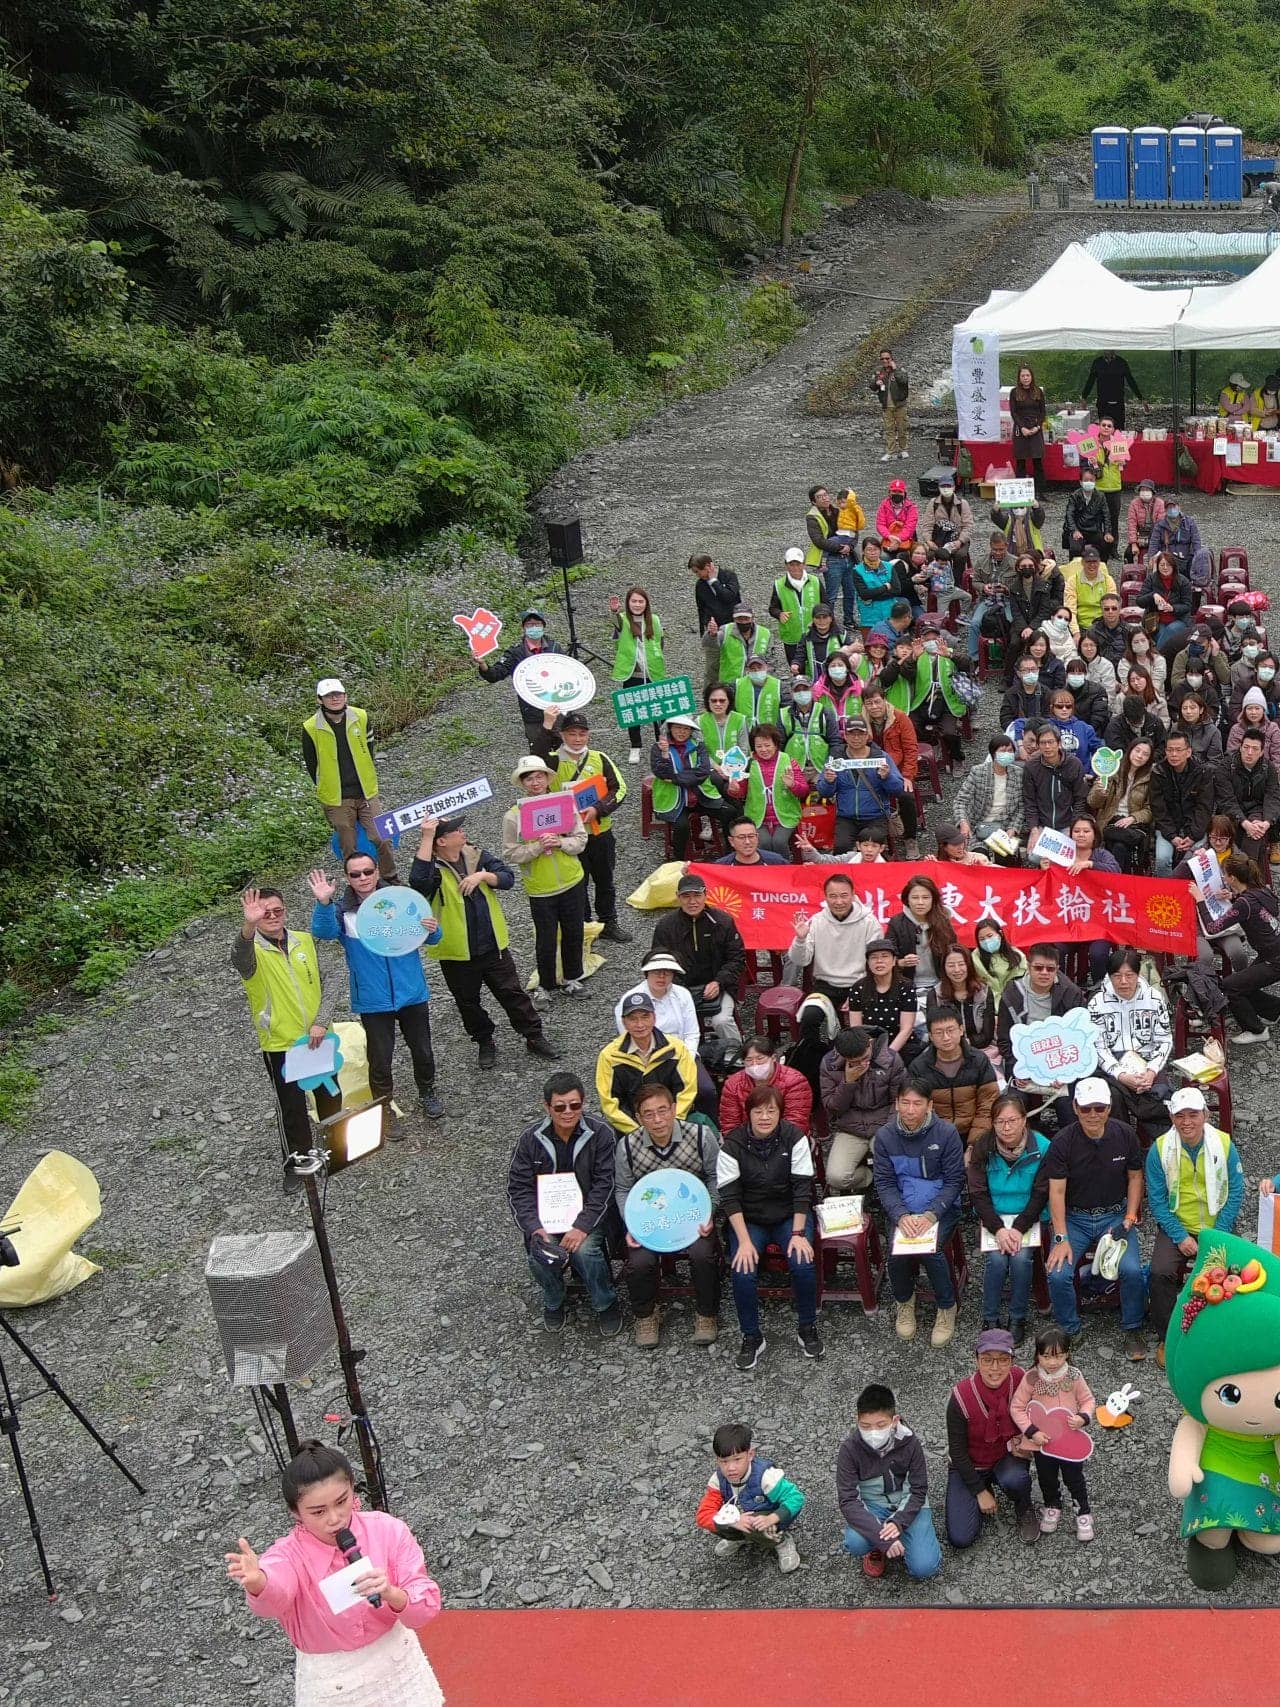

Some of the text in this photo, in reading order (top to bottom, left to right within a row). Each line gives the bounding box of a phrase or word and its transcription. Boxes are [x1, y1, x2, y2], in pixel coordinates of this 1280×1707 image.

[399, 787, 479, 826] 書上沒說的水保
[750, 891, 809, 904] TUNGDA
